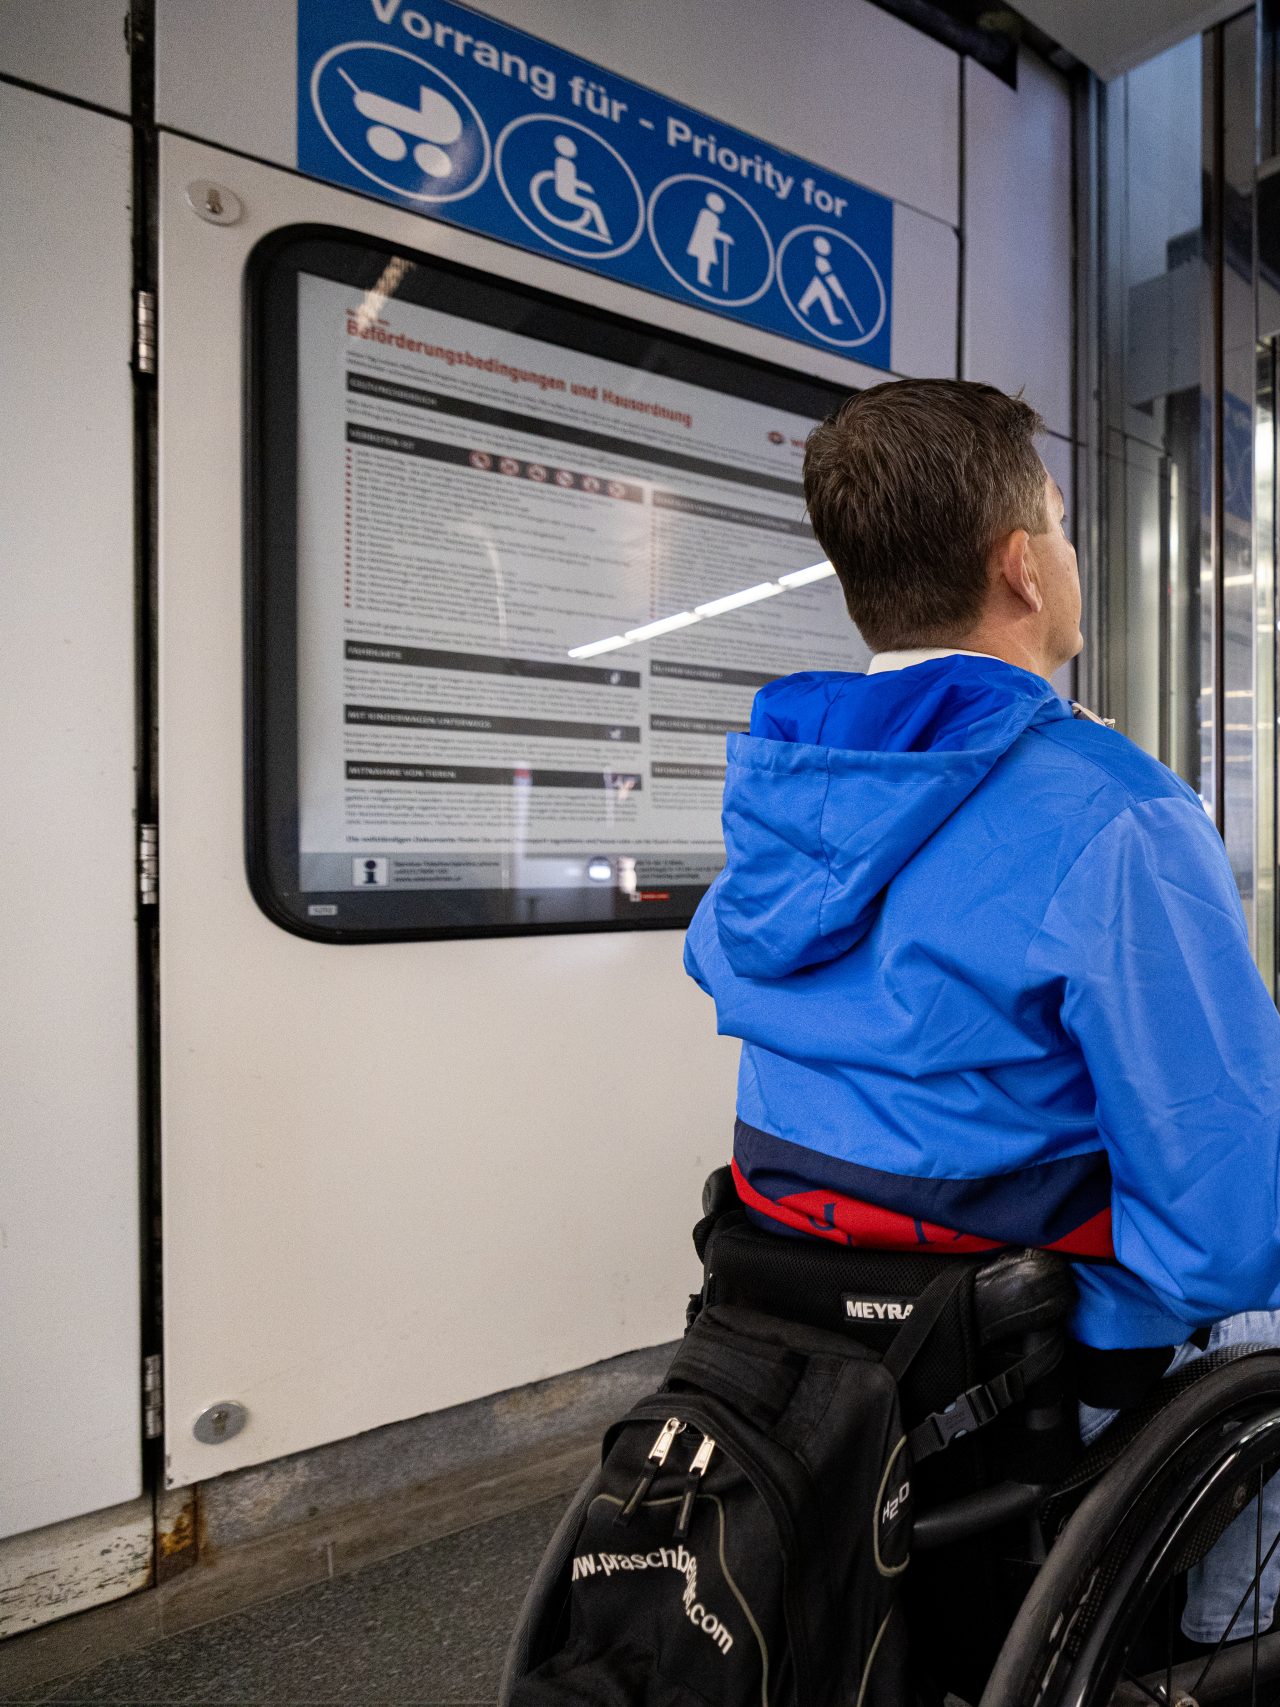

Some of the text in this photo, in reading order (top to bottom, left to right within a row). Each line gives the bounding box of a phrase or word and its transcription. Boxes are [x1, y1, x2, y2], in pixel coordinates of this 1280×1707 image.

[371, 0, 556, 101] Vorrang
[568, 75, 629, 123] für
[667, 116, 795, 200] Priority
[802, 177, 849, 218] for
[570, 383, 599, 401] und
[602, 387, 693, 429] Hausordnung
[846, 1300, 914, 1320] MEYRA
[882, 1481, 910, 1524] H2O
